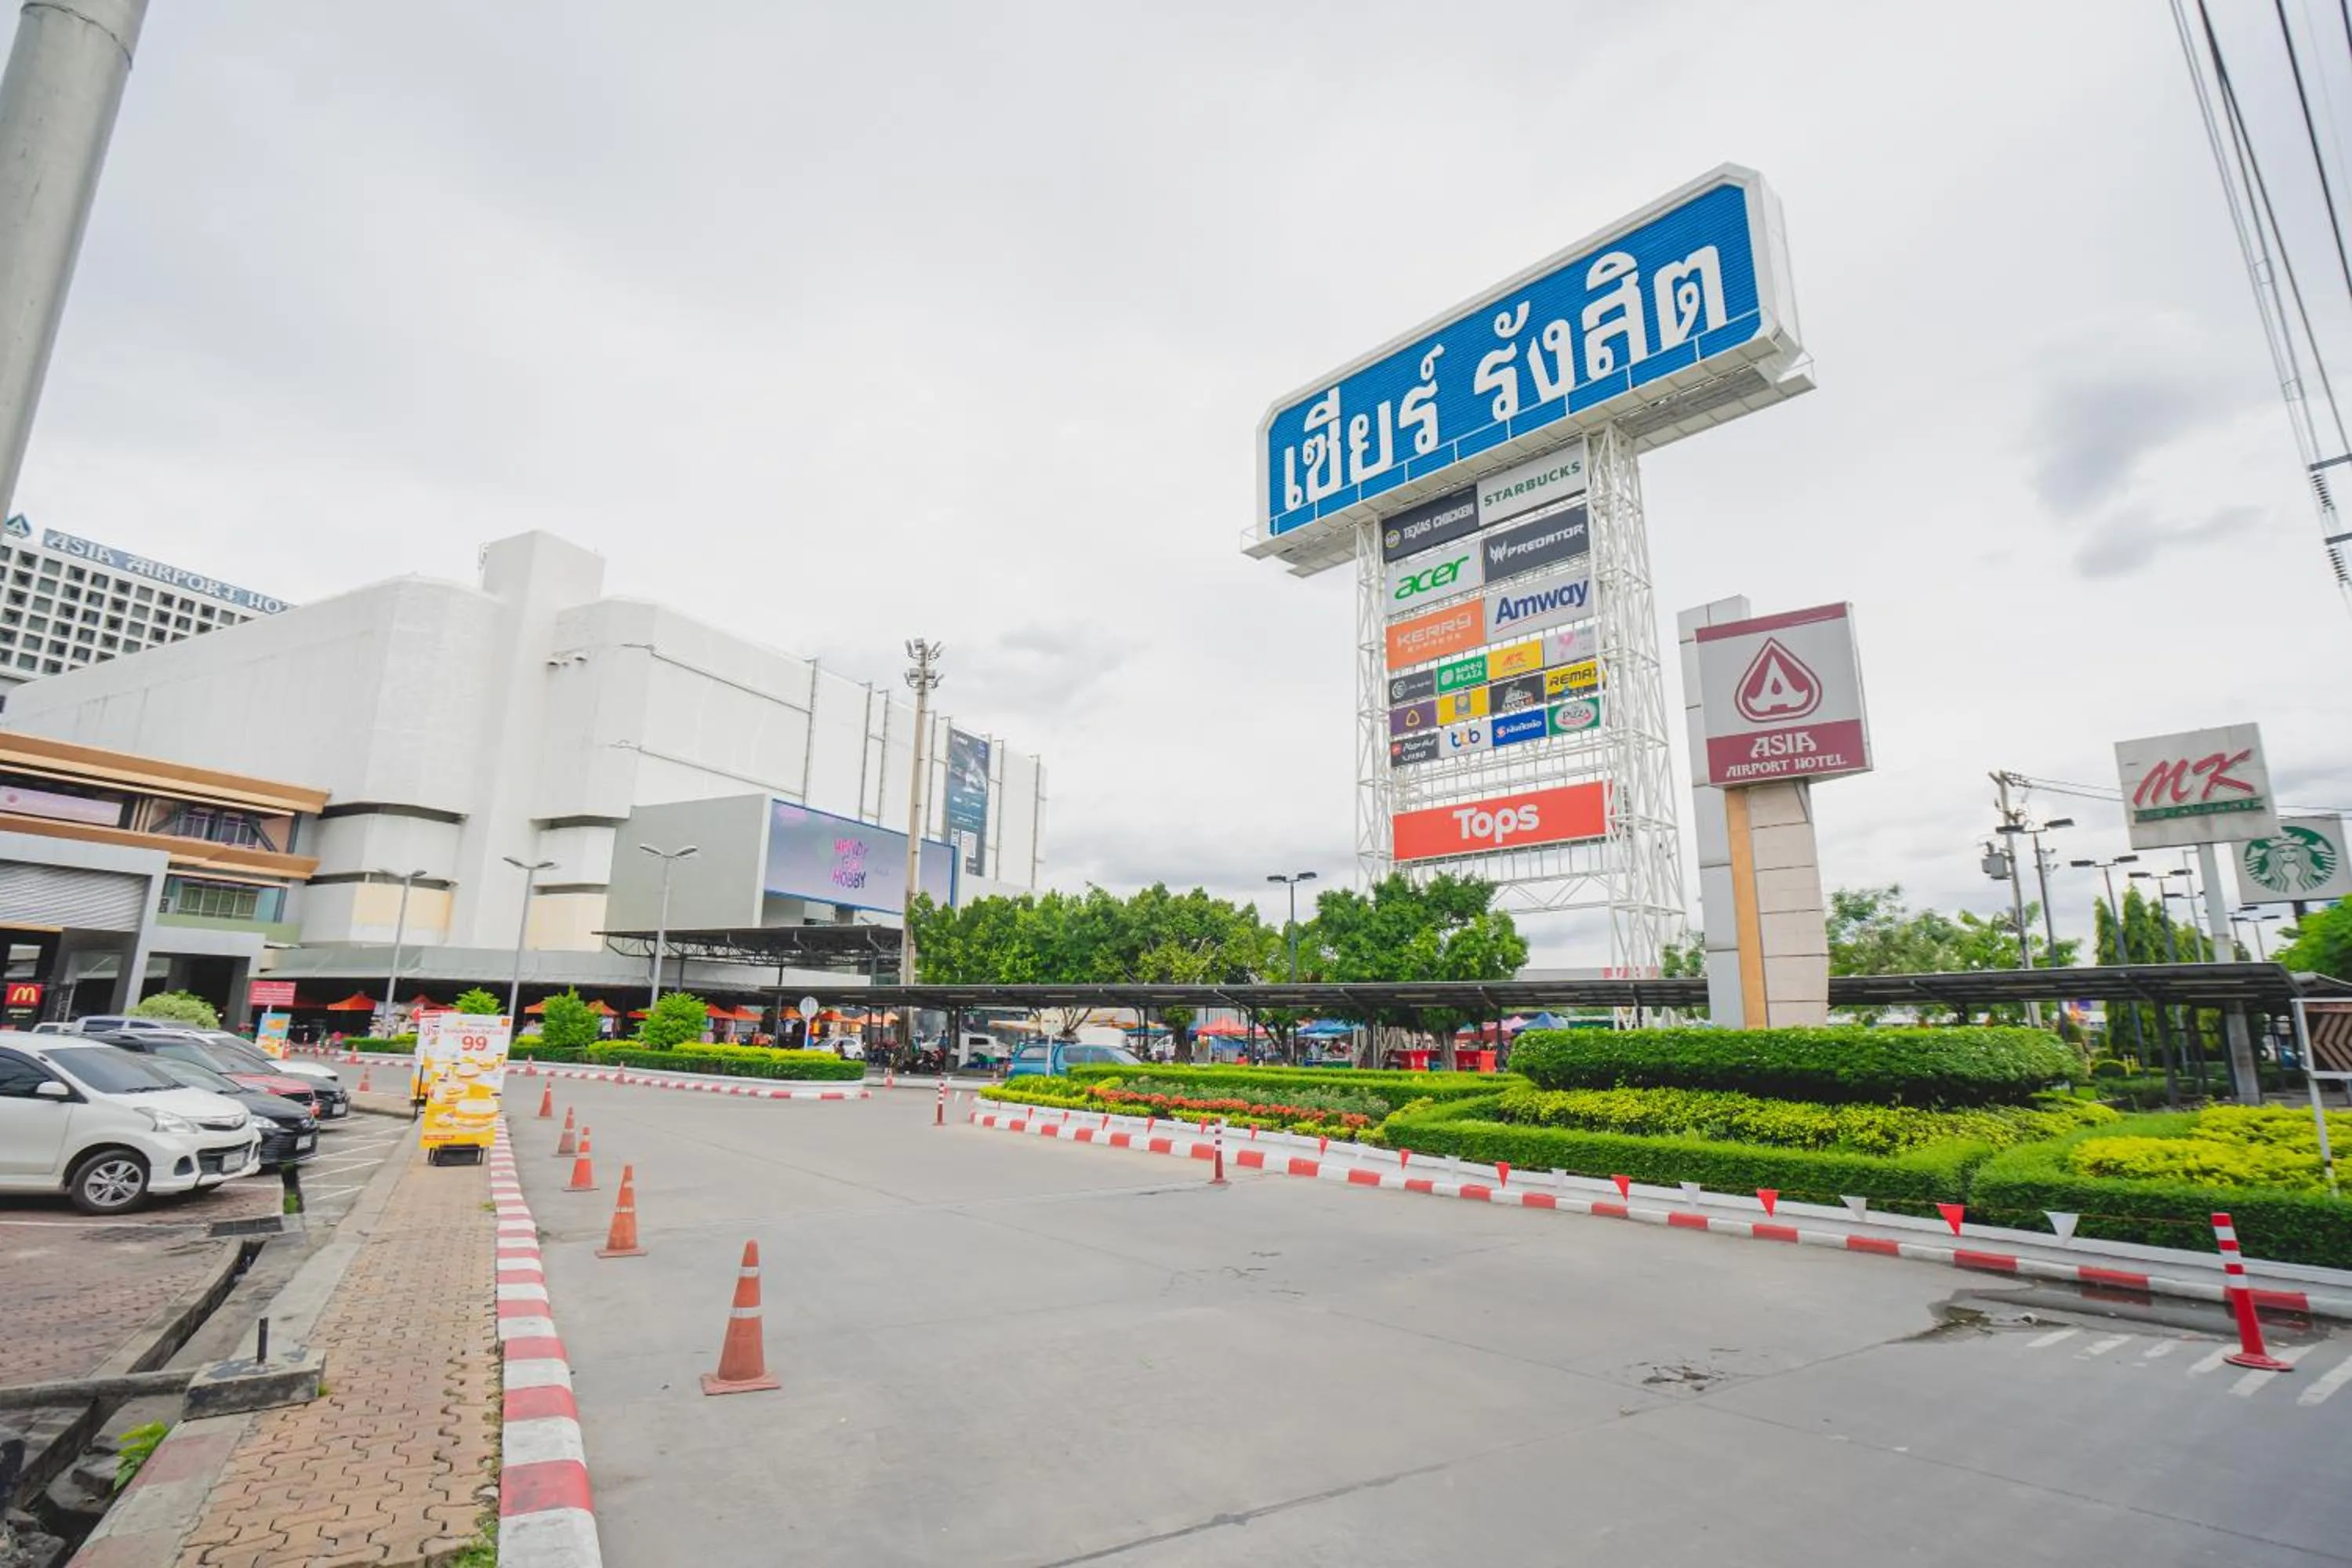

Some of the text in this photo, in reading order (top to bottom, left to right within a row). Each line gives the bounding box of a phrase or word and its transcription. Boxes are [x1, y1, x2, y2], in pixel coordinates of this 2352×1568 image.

[1284, 244, 1727, 511] เซียร์ รังสิต
[1484, 461, 1581, 507] STARBUCKS
[1403, 503, 1474, 539] TEXAS CHICKEN
[1508, 523, 1584, 557] PREDATOR
[47, 534, 115, 565] ASIA
[125, 555, 237, 600] AIRPORT
[1394, 555, 1470, 601] acer
[1495, 579, 1589, 625] Amway
[1726, 753, 1847, 779] AIRPORT HOTEL
[1750, 731, 1817, 758] ASIA
[2132, 748, 2256, 808] MK
[1453, 804, 1540, 844] Tops
[462, 1036, 488, 1051] 99
